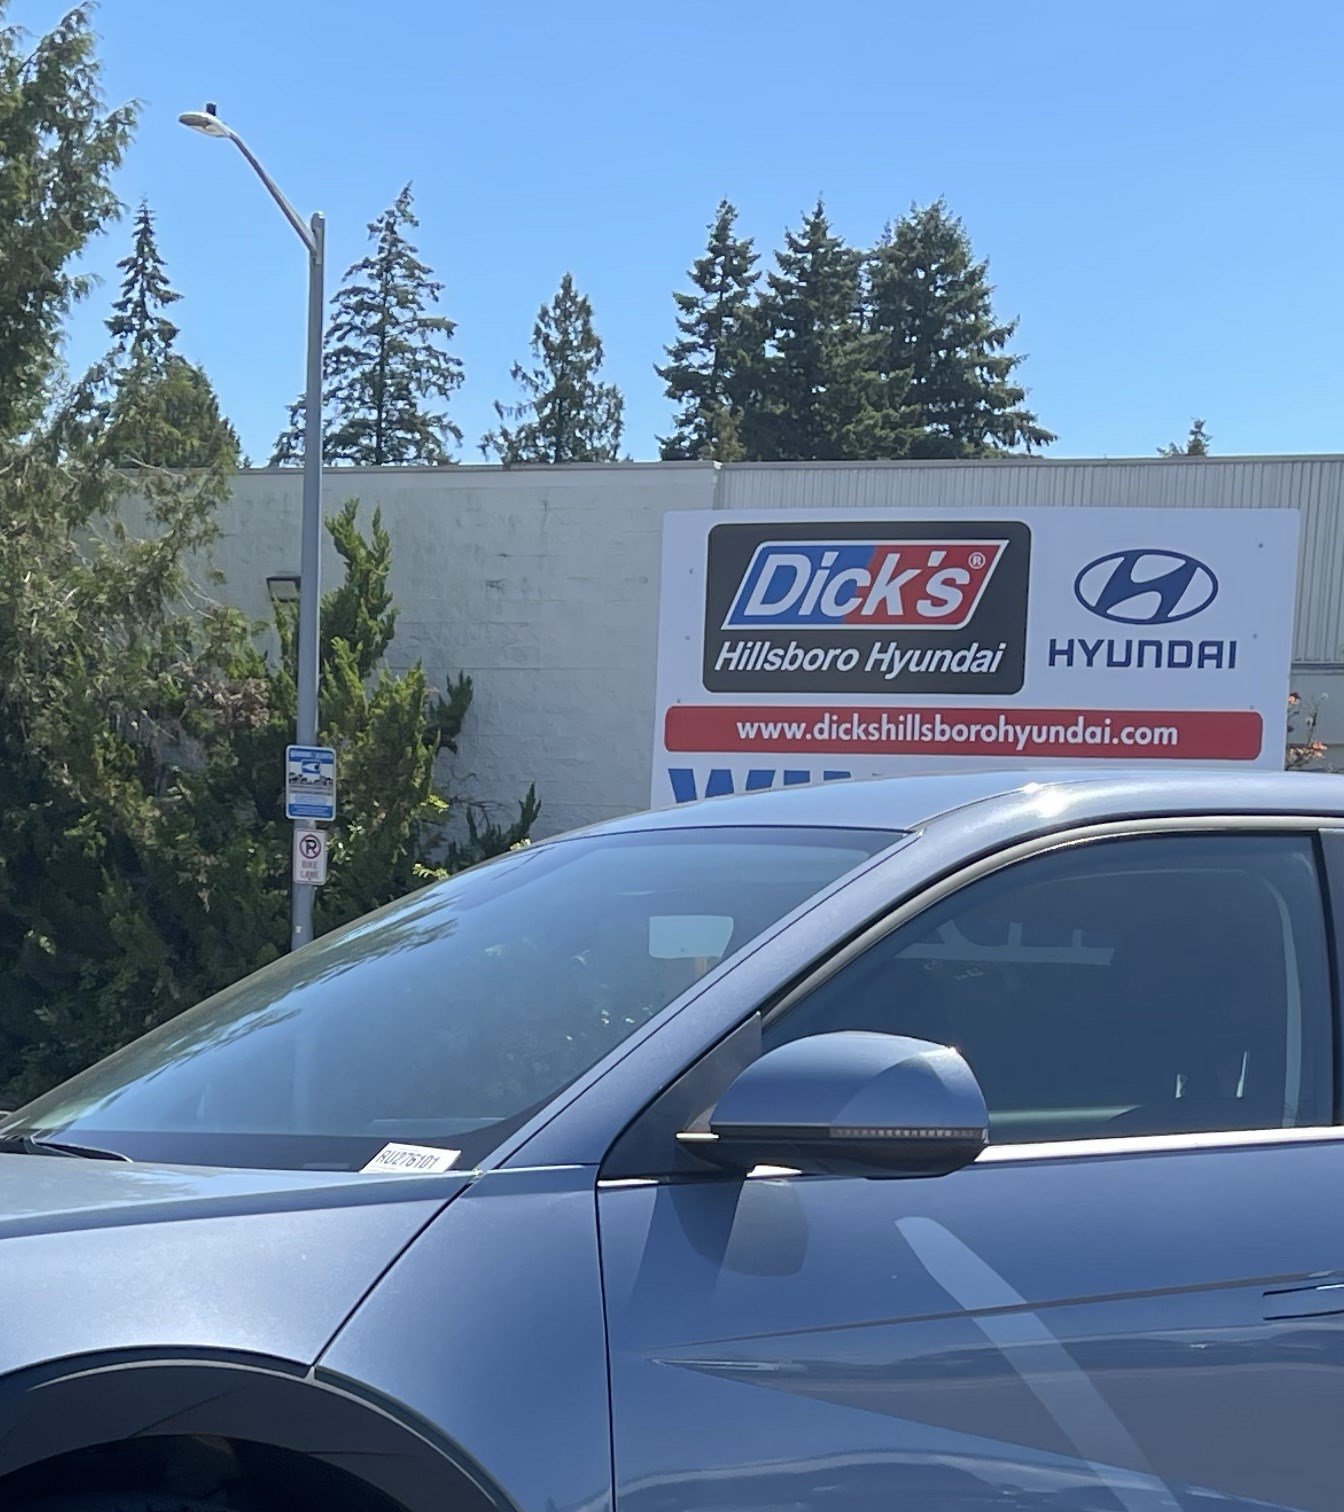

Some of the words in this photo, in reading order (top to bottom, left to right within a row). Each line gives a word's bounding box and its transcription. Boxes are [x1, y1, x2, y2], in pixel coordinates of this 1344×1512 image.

[715, 640, 860, 674] Hillsboro
[865, 641, 1006, 680] Hyundai
[1049, 638, 1237, 669] HYUNDAI
[736, 713, 1179, 752] www.dickshillsborohyundai.com
